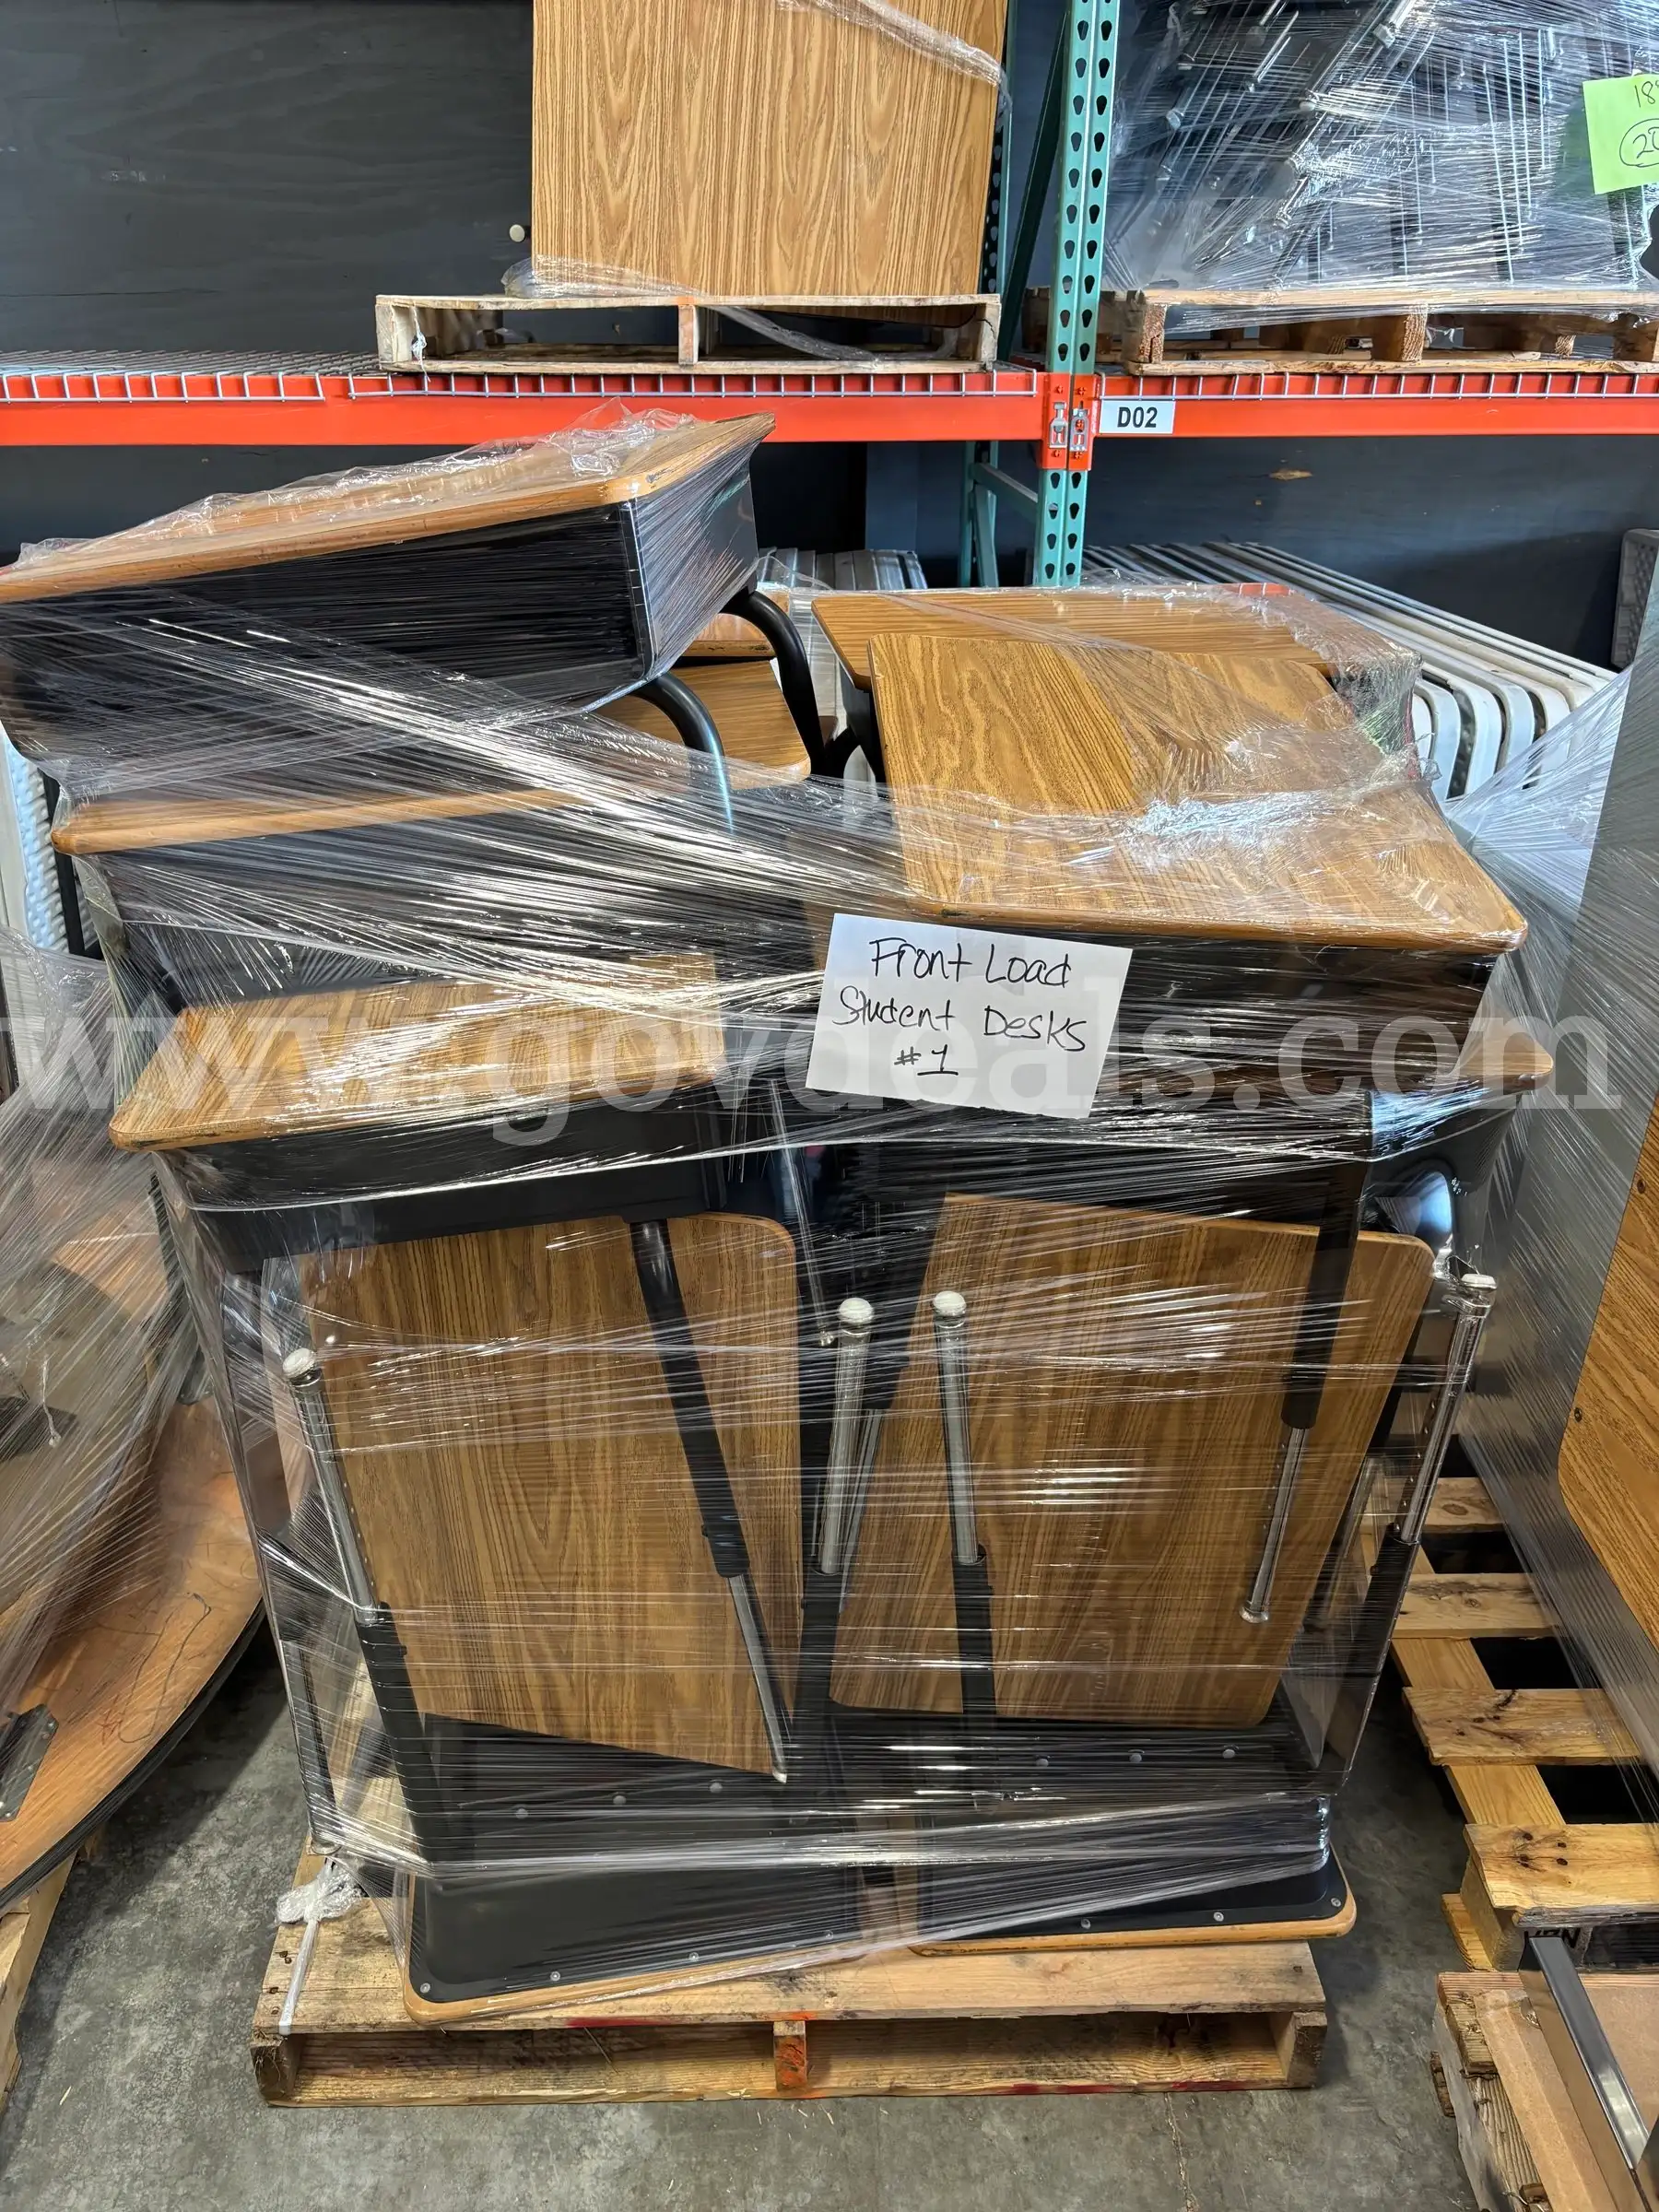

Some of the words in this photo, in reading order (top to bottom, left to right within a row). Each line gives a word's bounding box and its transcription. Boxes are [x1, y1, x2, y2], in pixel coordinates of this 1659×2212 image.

[1635, 80, 1659, 108] 18
[1117, 406, 1158, 429] D02
[869, 937, 972, 982] Front
[985, 943, 1071, 988] Load
[831, 984, 955, 1032] Student
